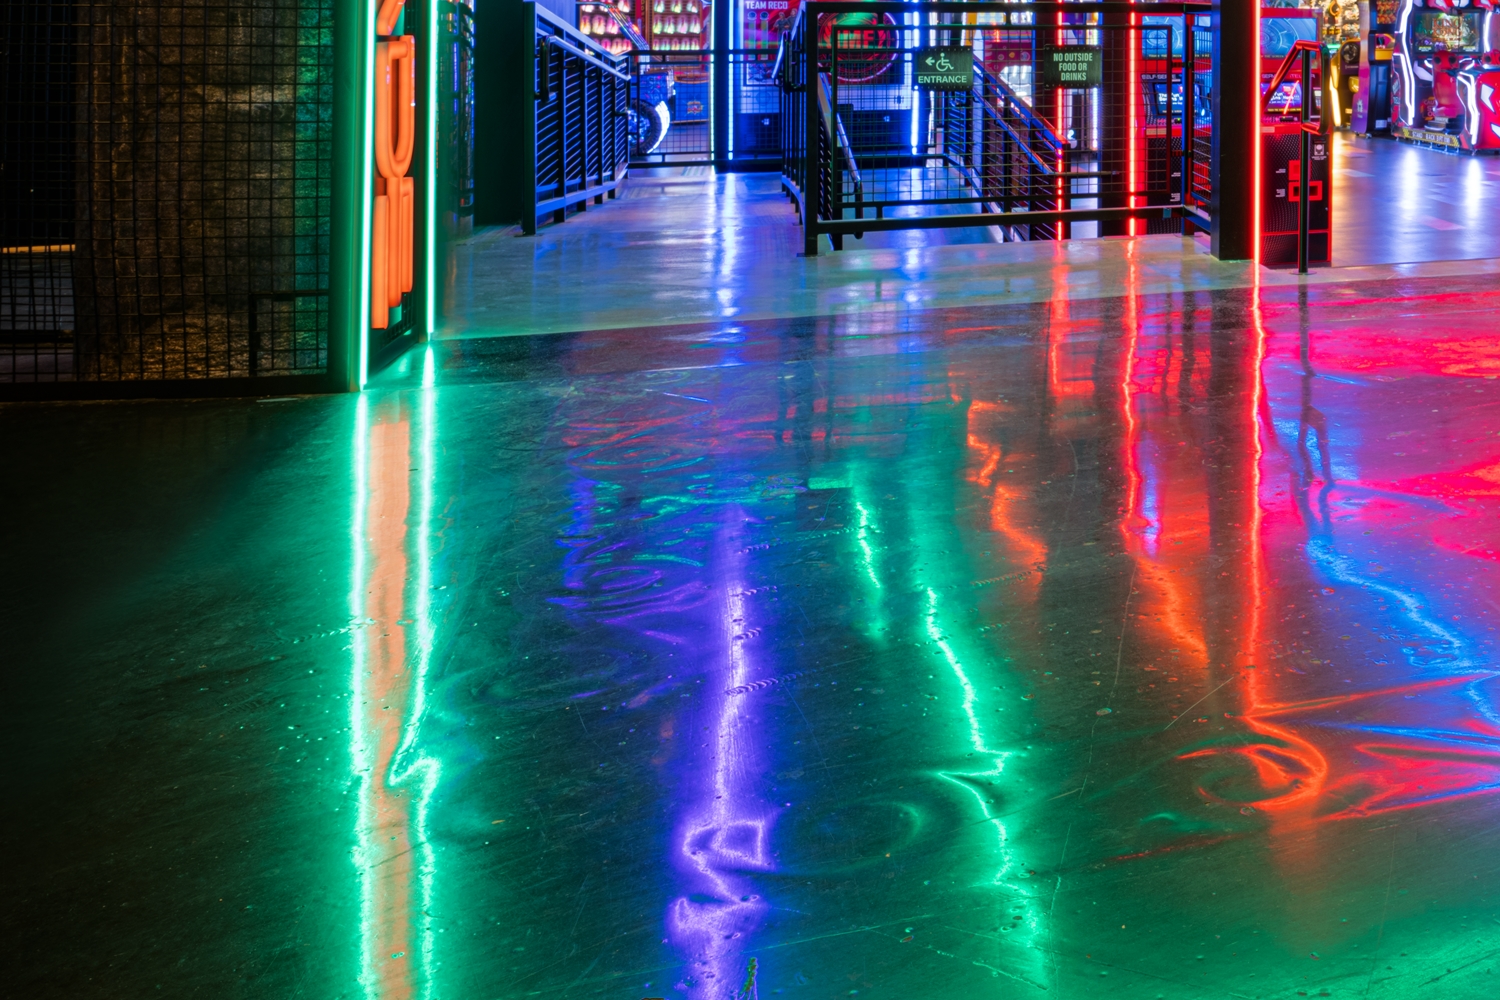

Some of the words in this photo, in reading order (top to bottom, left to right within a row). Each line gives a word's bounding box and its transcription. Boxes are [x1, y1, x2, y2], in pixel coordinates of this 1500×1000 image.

[745, 1, 767, 9] TEAM
[768, 1, 788, 9] RECO
[1053, 53, 1063, 62] NO
[1064, 53, 1093, 62] OUTSIDE
[1058, 63, 1077, 71] FOOD
[1077, 63, 1087, 71] OR
[918, 75, 967, 84] ENTRANCE
[1061, 72, 1087, 81] DRINKS
